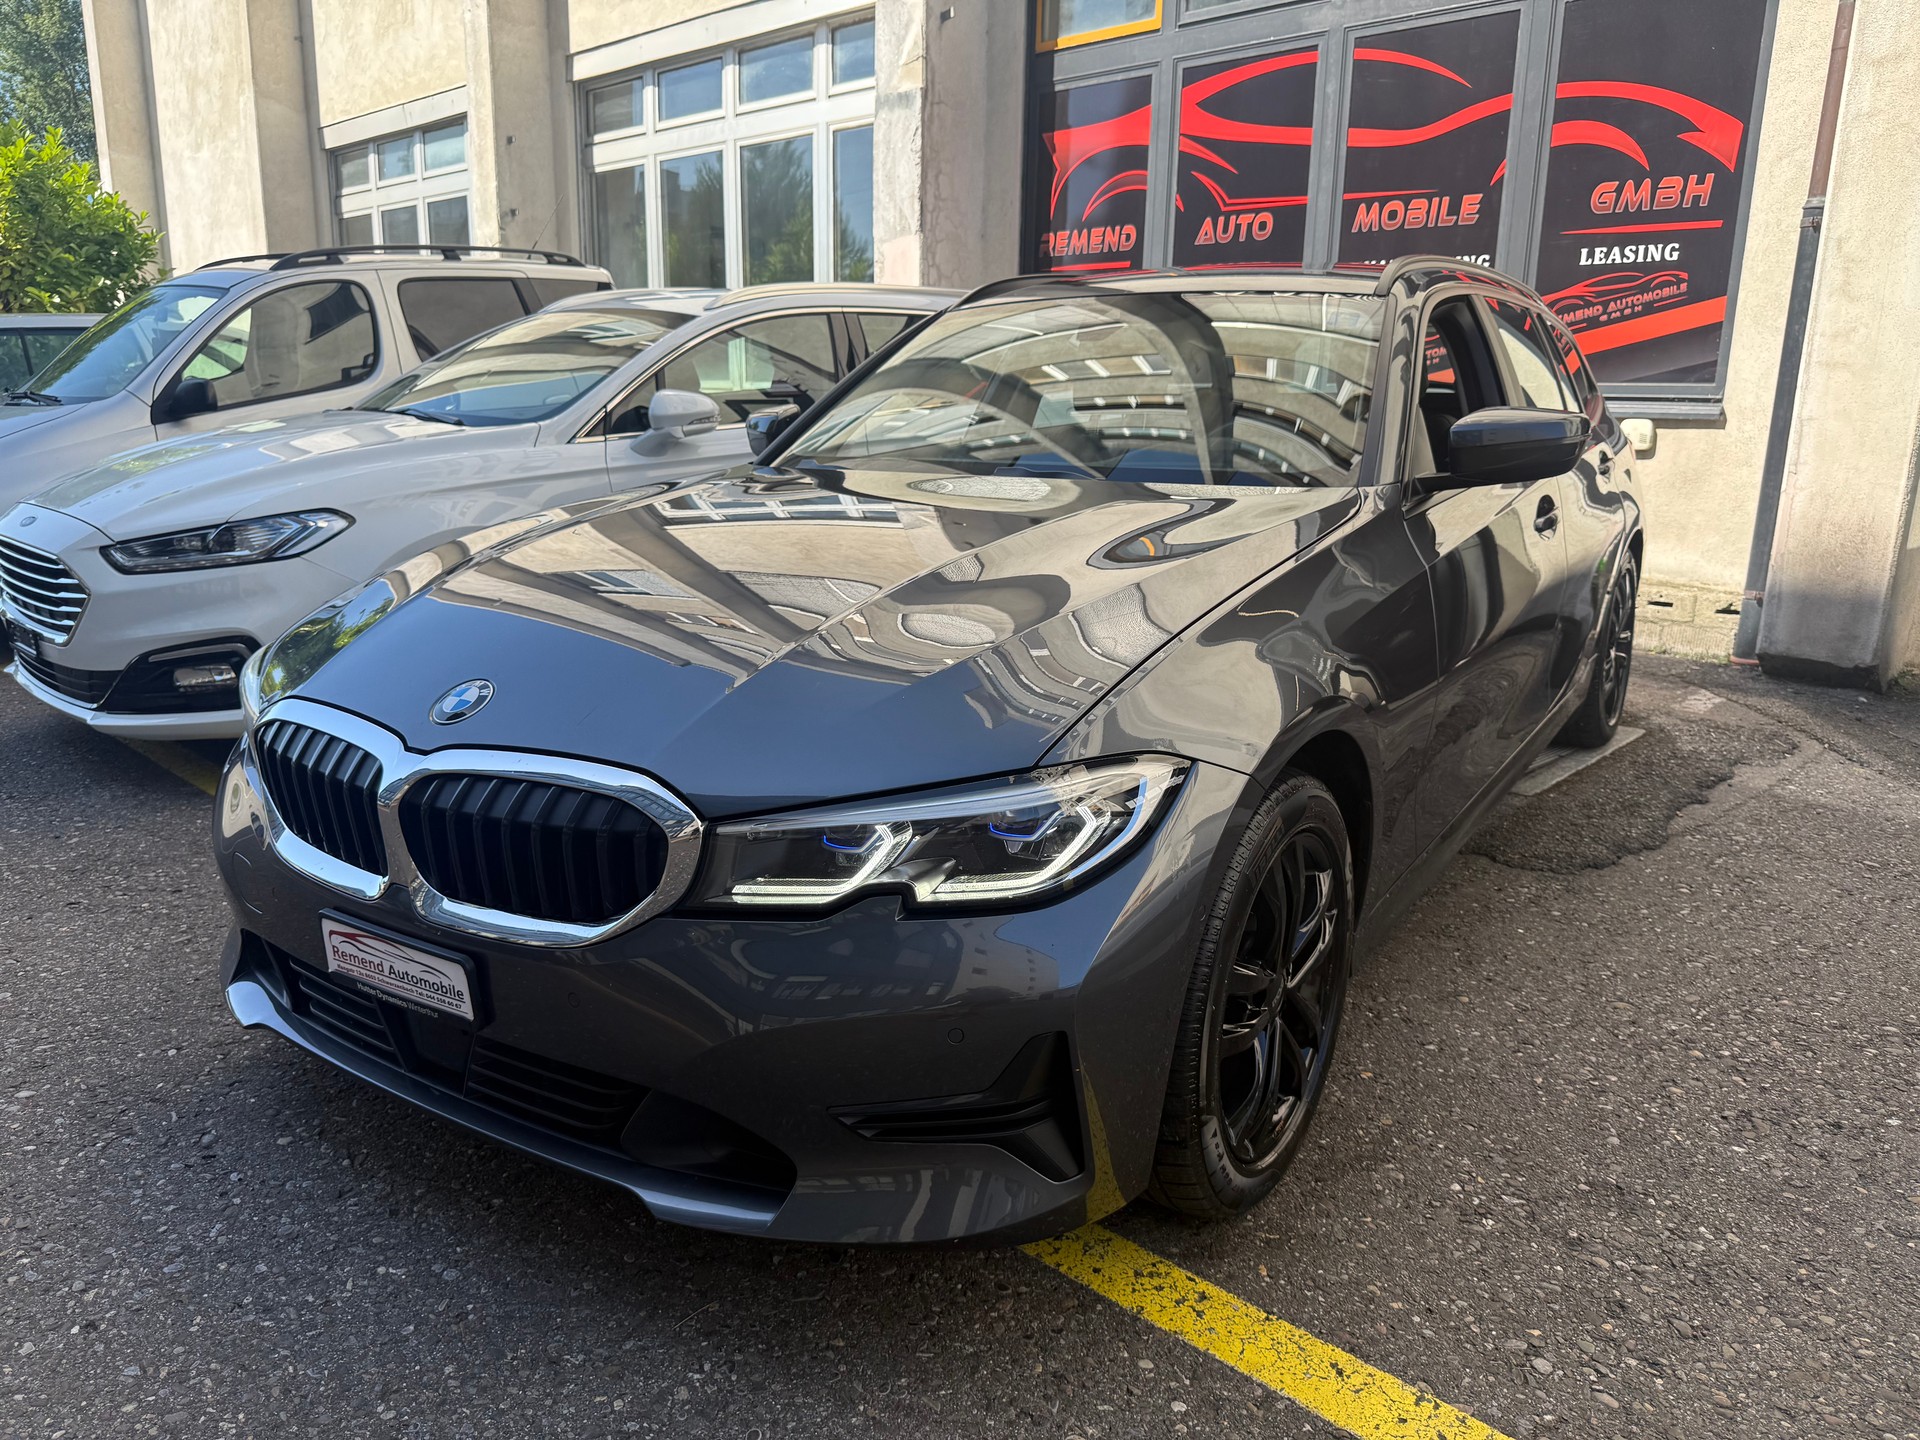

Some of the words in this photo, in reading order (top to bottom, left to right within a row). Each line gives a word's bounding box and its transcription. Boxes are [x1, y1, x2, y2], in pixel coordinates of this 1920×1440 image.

[1039, 223, 1137, 257] REMEND
[1194, 212, 1274, 246] AUTO
[1351, 193, 1484, 233] MOBILE
[1590, 173, 1715, 214] GMBH
[1578, 242, 1680, 265] LEASING
[1559, 305, 1603, 324] MEND
[1606, 281, 1689, 313] AUTOMOBILE
[332, 945, 385, 974] Remend
[388, 964, 464, 1000] Automobile
[425, 992, 436, 1001] 044
